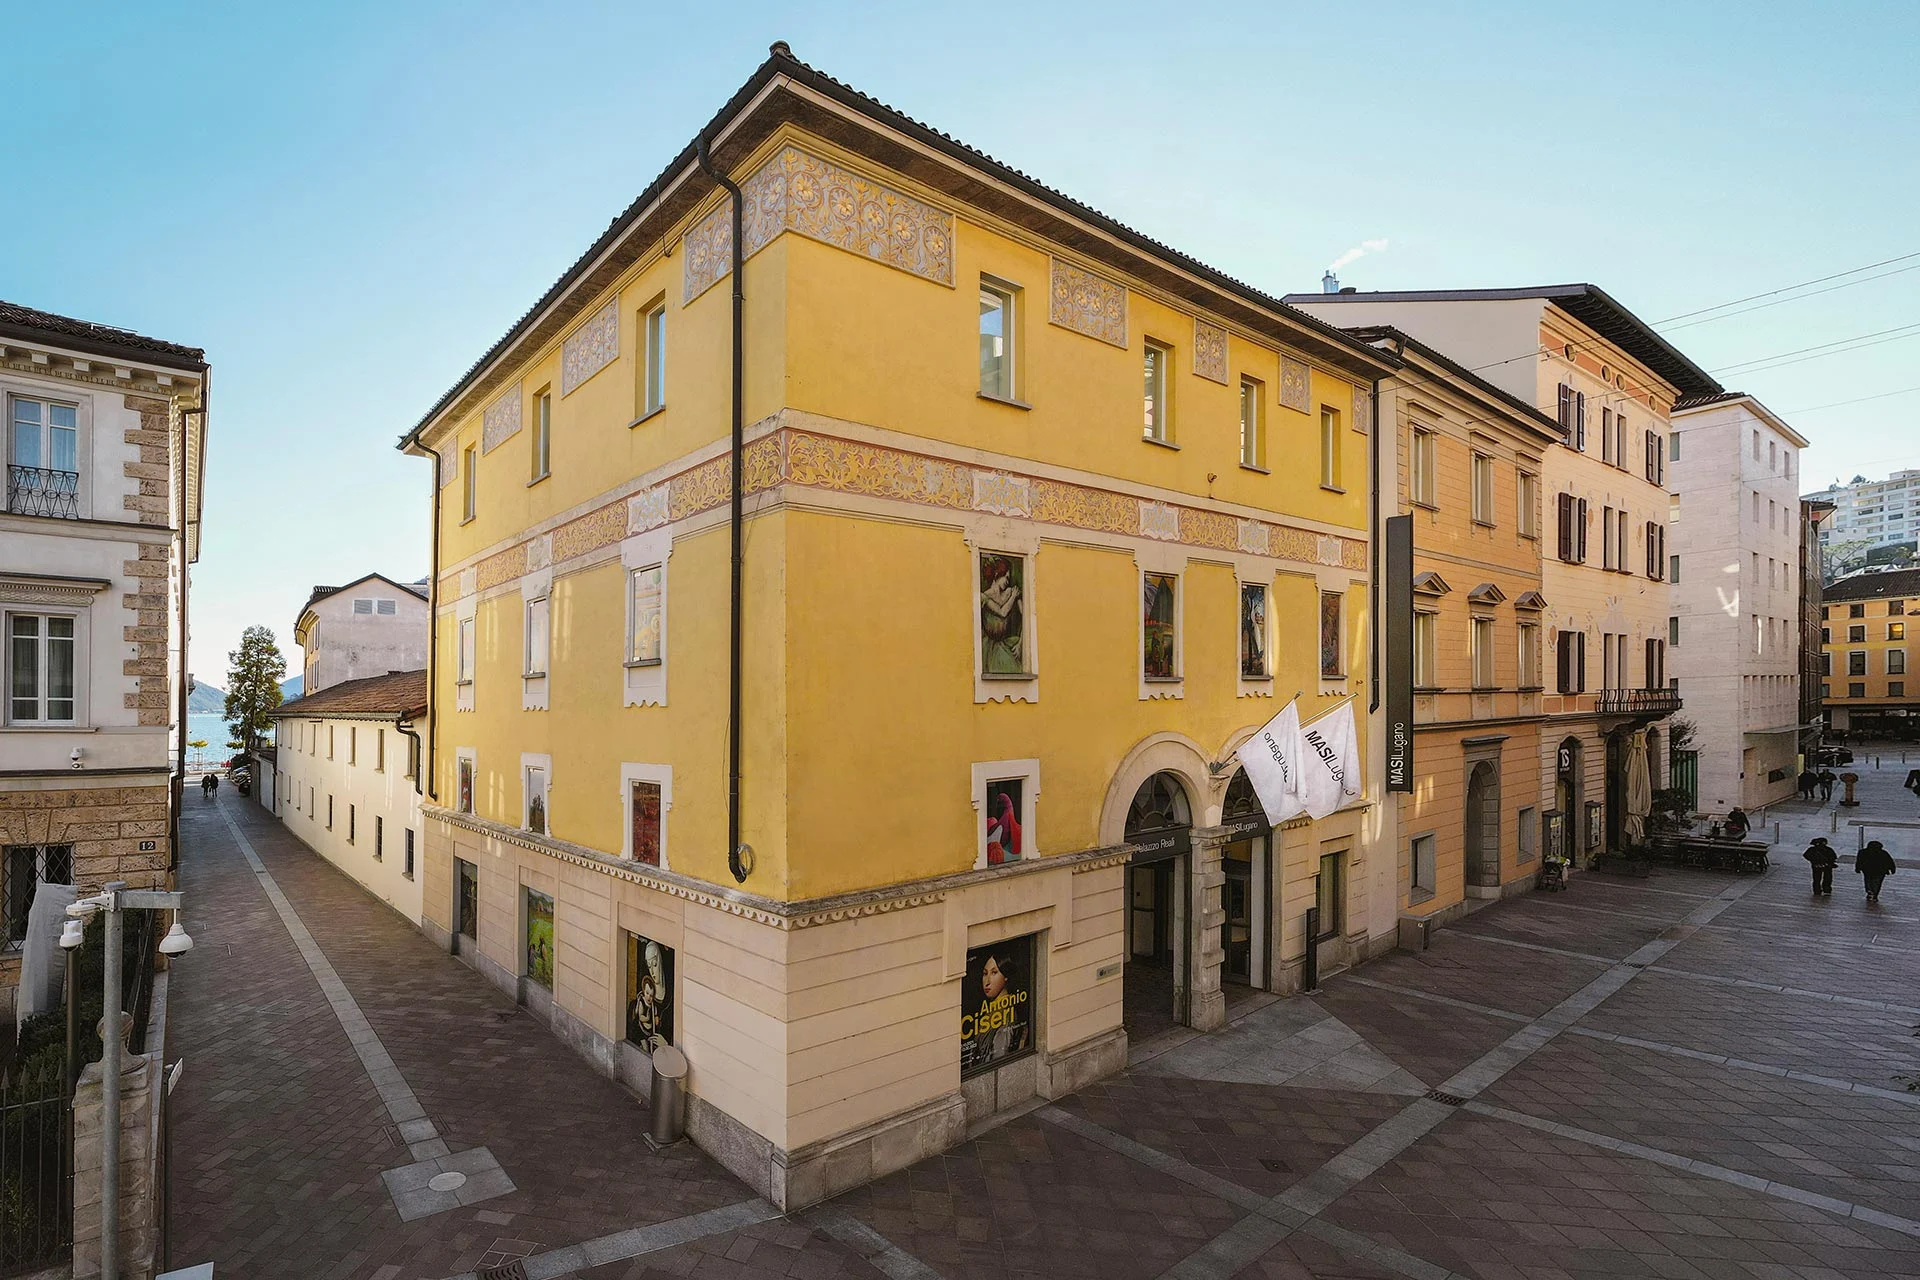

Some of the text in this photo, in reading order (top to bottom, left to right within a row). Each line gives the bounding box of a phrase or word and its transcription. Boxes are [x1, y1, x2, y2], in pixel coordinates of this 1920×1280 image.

[1305, 730, 1356, 796] MASILug
[1390, 722, 1408, 785] MASILugano
[141, 841, 154, 850] 12
[1135, 836, 1175, 854] Palazzo Reali
[980, 989, 1028, 1016] Antonio
[961, 1006, 1015, 1040] Ciseri
